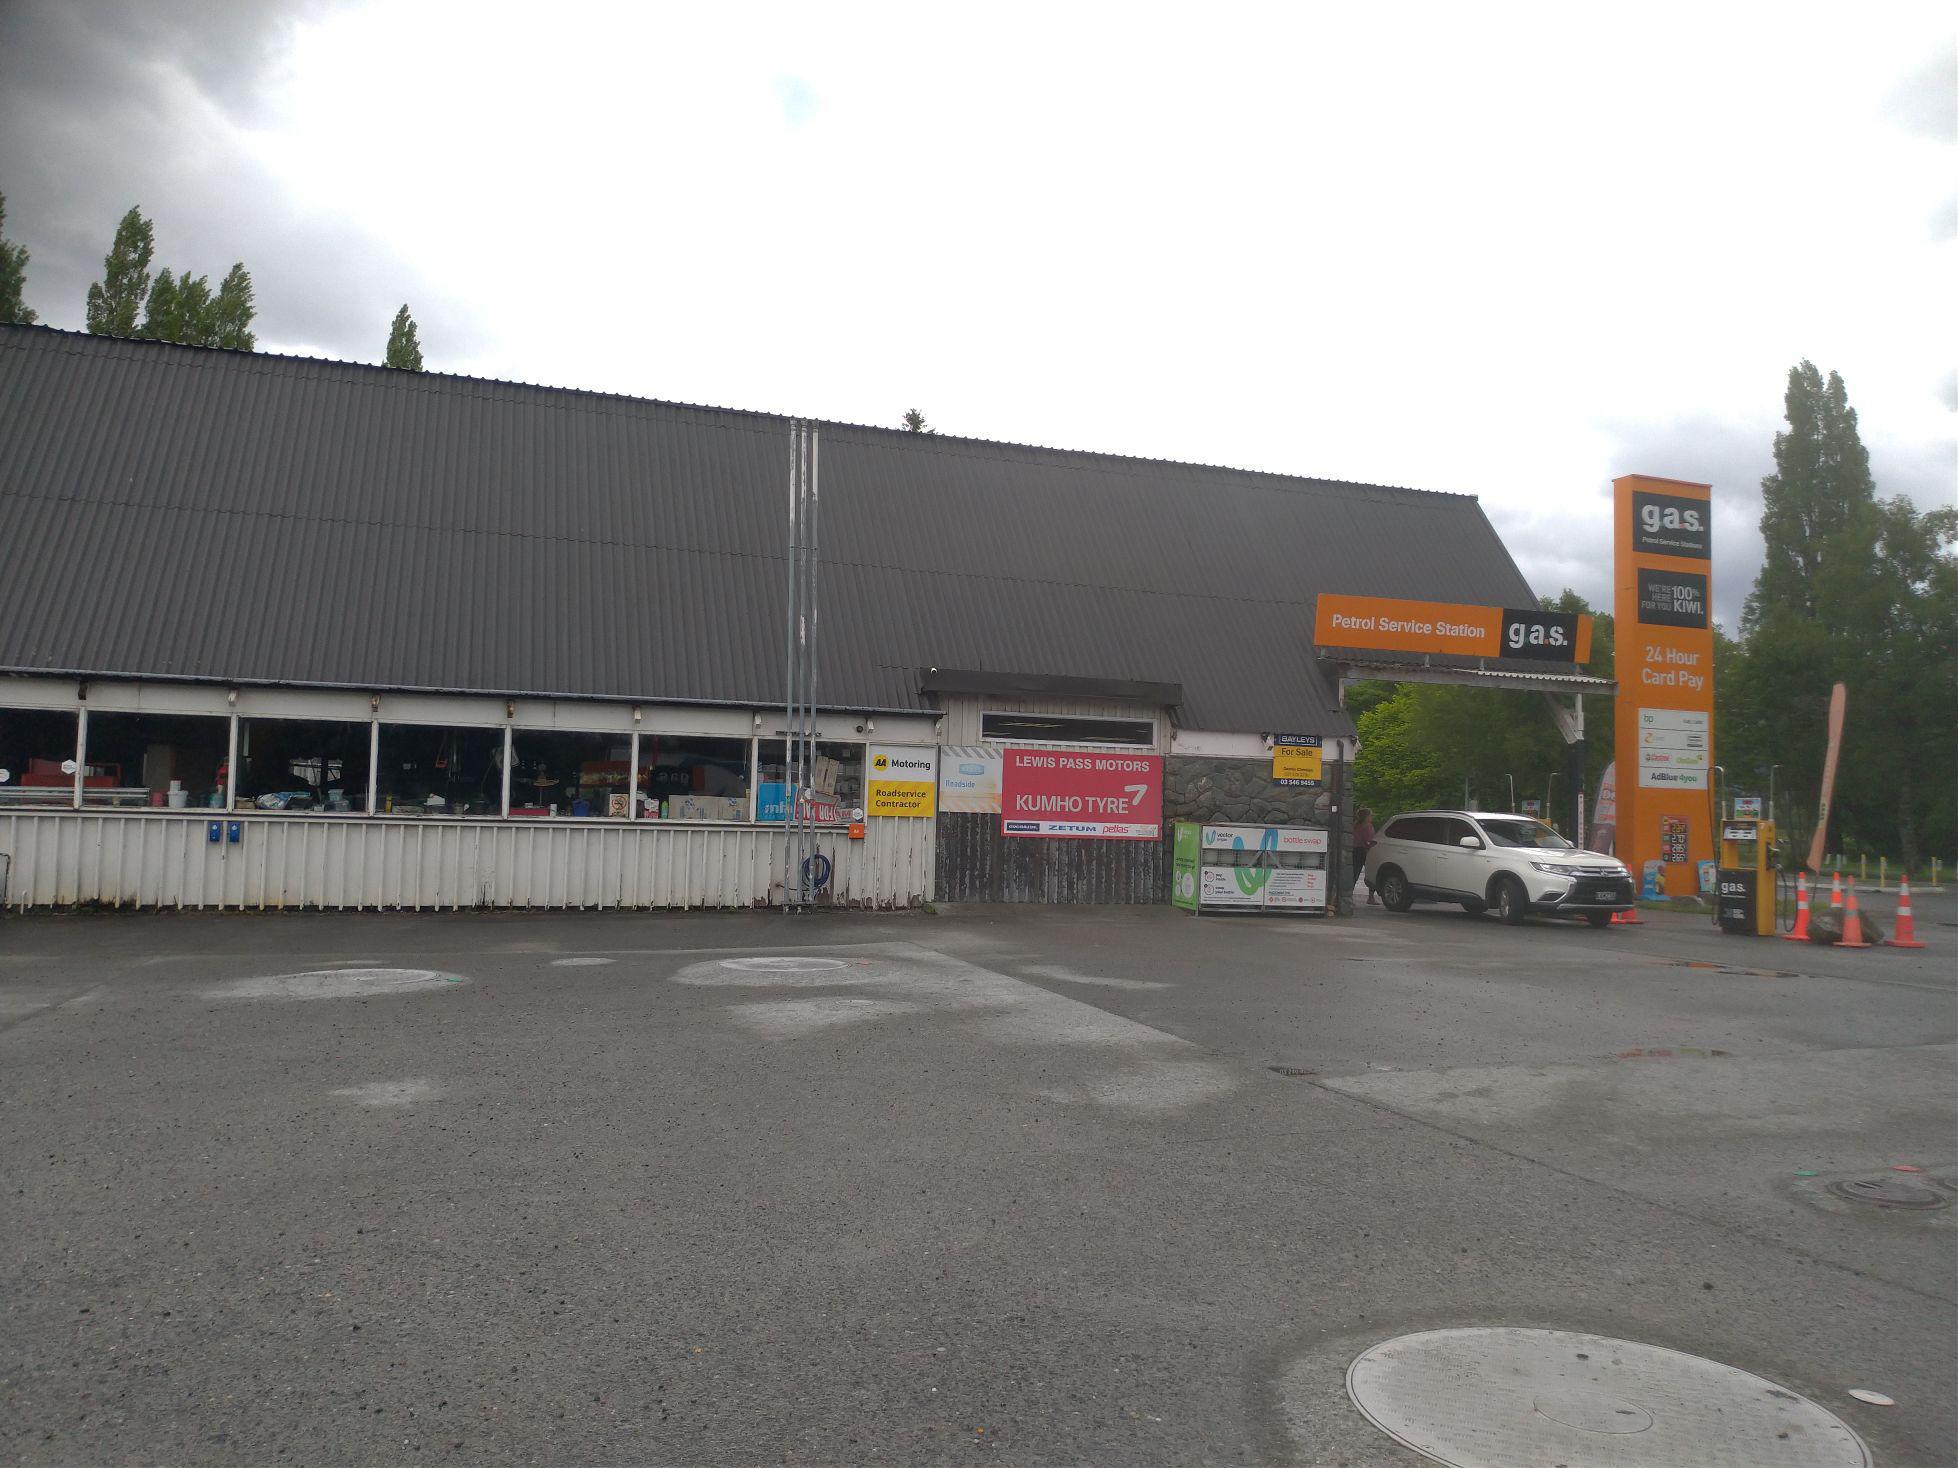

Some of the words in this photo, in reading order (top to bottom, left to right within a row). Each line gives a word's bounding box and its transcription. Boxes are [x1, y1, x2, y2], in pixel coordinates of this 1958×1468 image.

[1651, 592, 1672, 602] HERE
[1641, 600, 1656, 609] FOR
[1657, 602, 1672, 611] YOU
[1331, 613, 1375, 631] Petrol
[1378, 617, 1432, 635] Service
[1436, 621, 1485, 638] Station
[1645, 645, 1663, 663] 24
[1666, 647, 1699, 666] Hour
[1642, 667, 1675, 686] Card
[1679, 670, 1704, 691] Pay
[1281, 735, 1315, 743] BAYLEYS
[1281, 747, 1294, 756] For
[1296, 748, 1313, 757] Sale
[891, 759, 931, 771] Motoring
[1015, 755, 1056, 768] LEWIS
[1059, 757, 1092, 770] PASS
[1095, 760, 1150, 772] MOTORS
[1651, 772, 1678, 781] AdBlue
[1679, 774, 1697, 784] 4you
[876, 789, 927, 798] Roadservice
[875, 799, 921, 808] Contractor
[1015, 794, 1083, 812] KUMHO
[1085, 796, 1129, 814] TYRE
[1048, 824, 1097, 832] ZETUM
[1283, 836, 1303, 844] bottle
